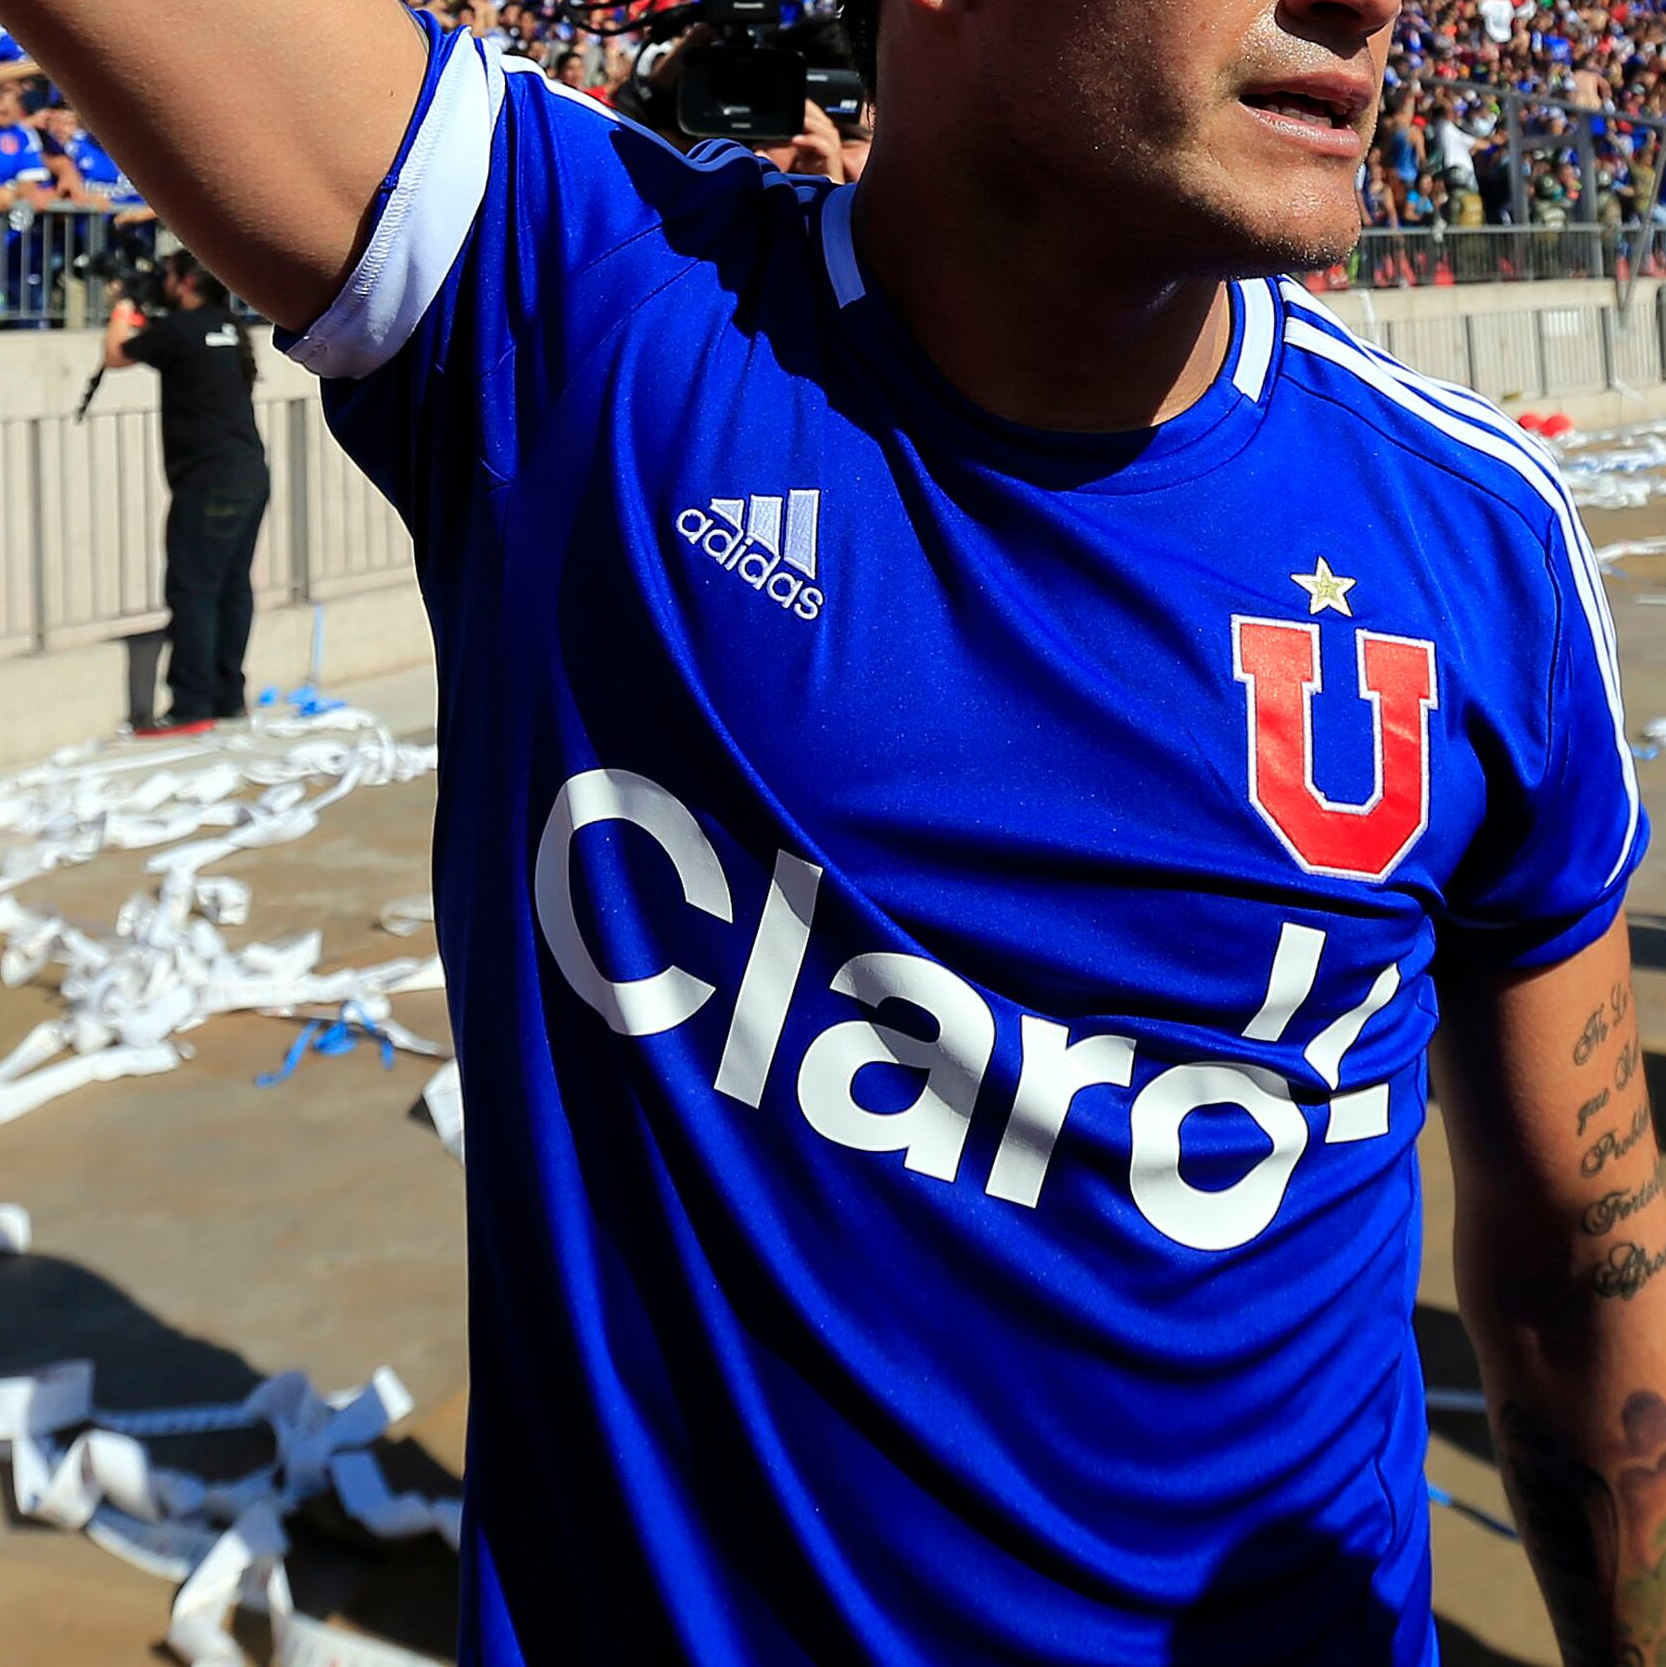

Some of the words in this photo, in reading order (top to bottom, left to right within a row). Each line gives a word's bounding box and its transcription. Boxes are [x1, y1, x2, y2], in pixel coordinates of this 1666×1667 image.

[676, 508, 825, 621] adidas
[1230, 614, 1438, 883] U
[534, 768, 1308, 1251] Claro
